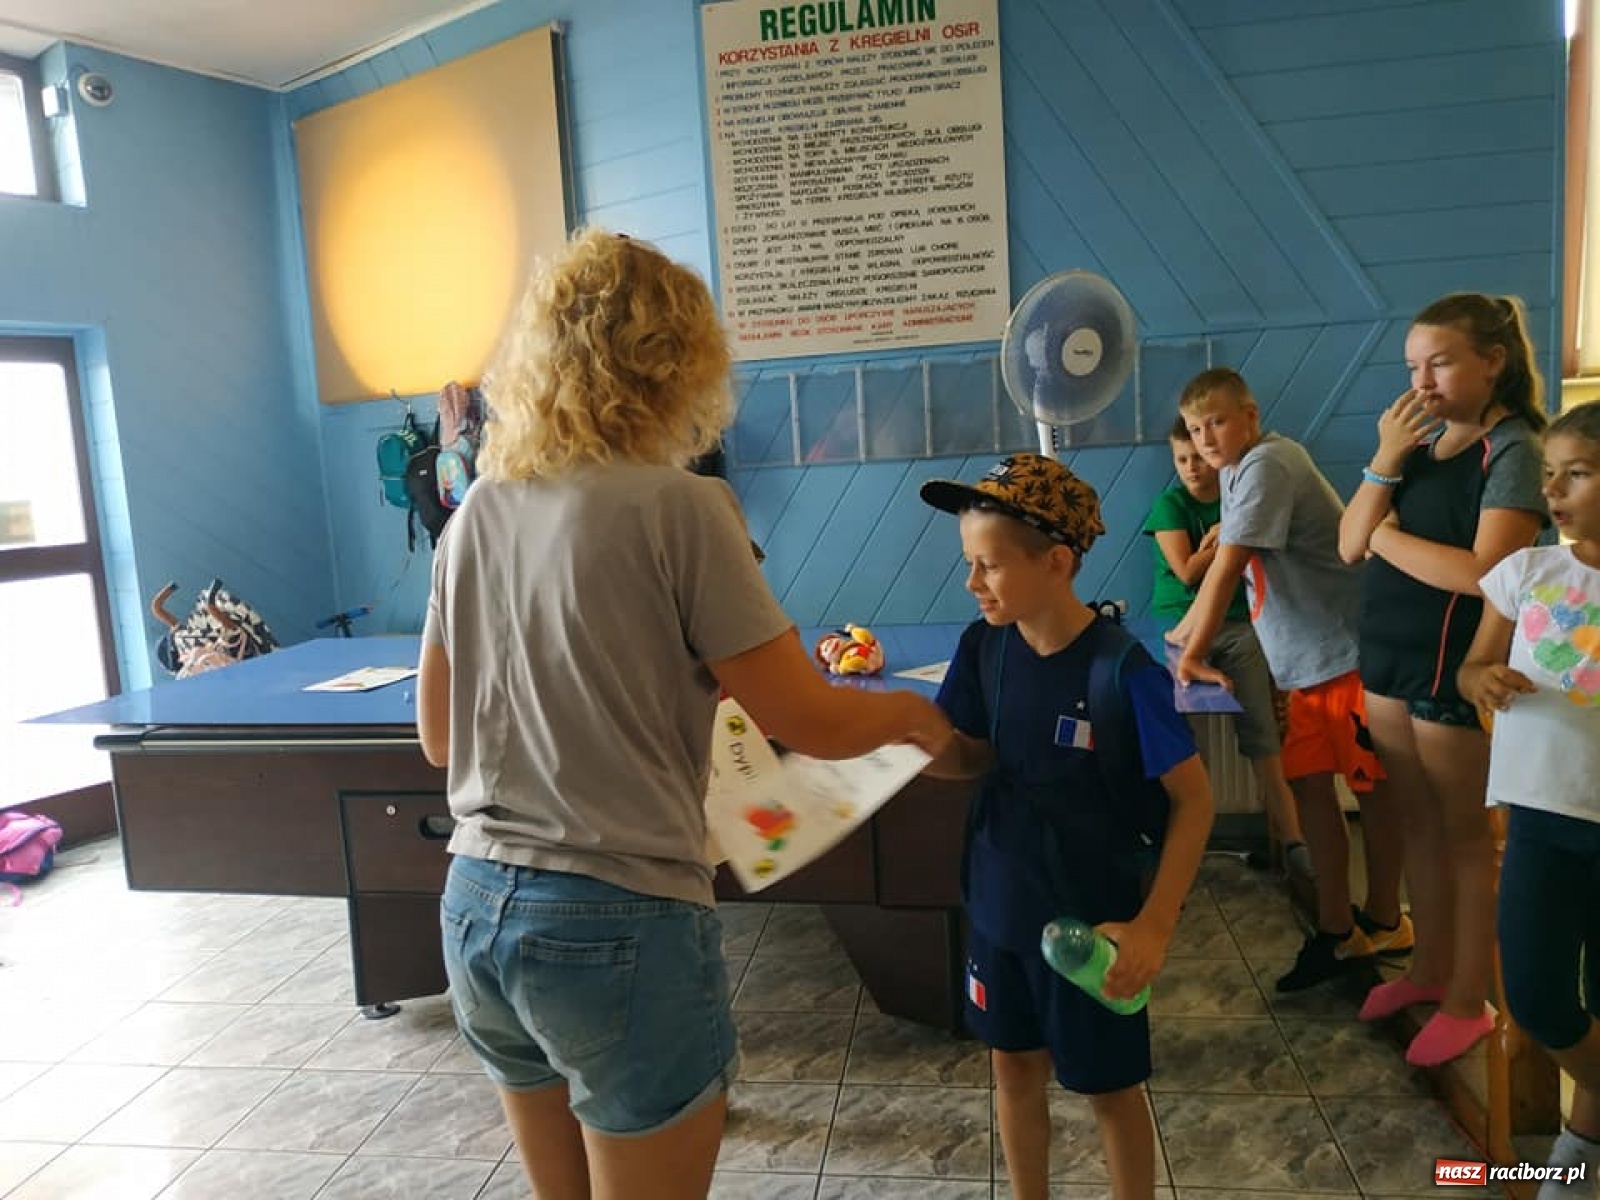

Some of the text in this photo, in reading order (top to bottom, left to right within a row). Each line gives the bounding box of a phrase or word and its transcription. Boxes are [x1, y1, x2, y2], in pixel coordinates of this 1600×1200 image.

[760, 0, 936, 41] REGULAMIN
[718, 41, 819, 65] KORZYSTANIA
[829, 39, 839, 52] Z
[850, 27, 931, 50] KRĘGIELNI
